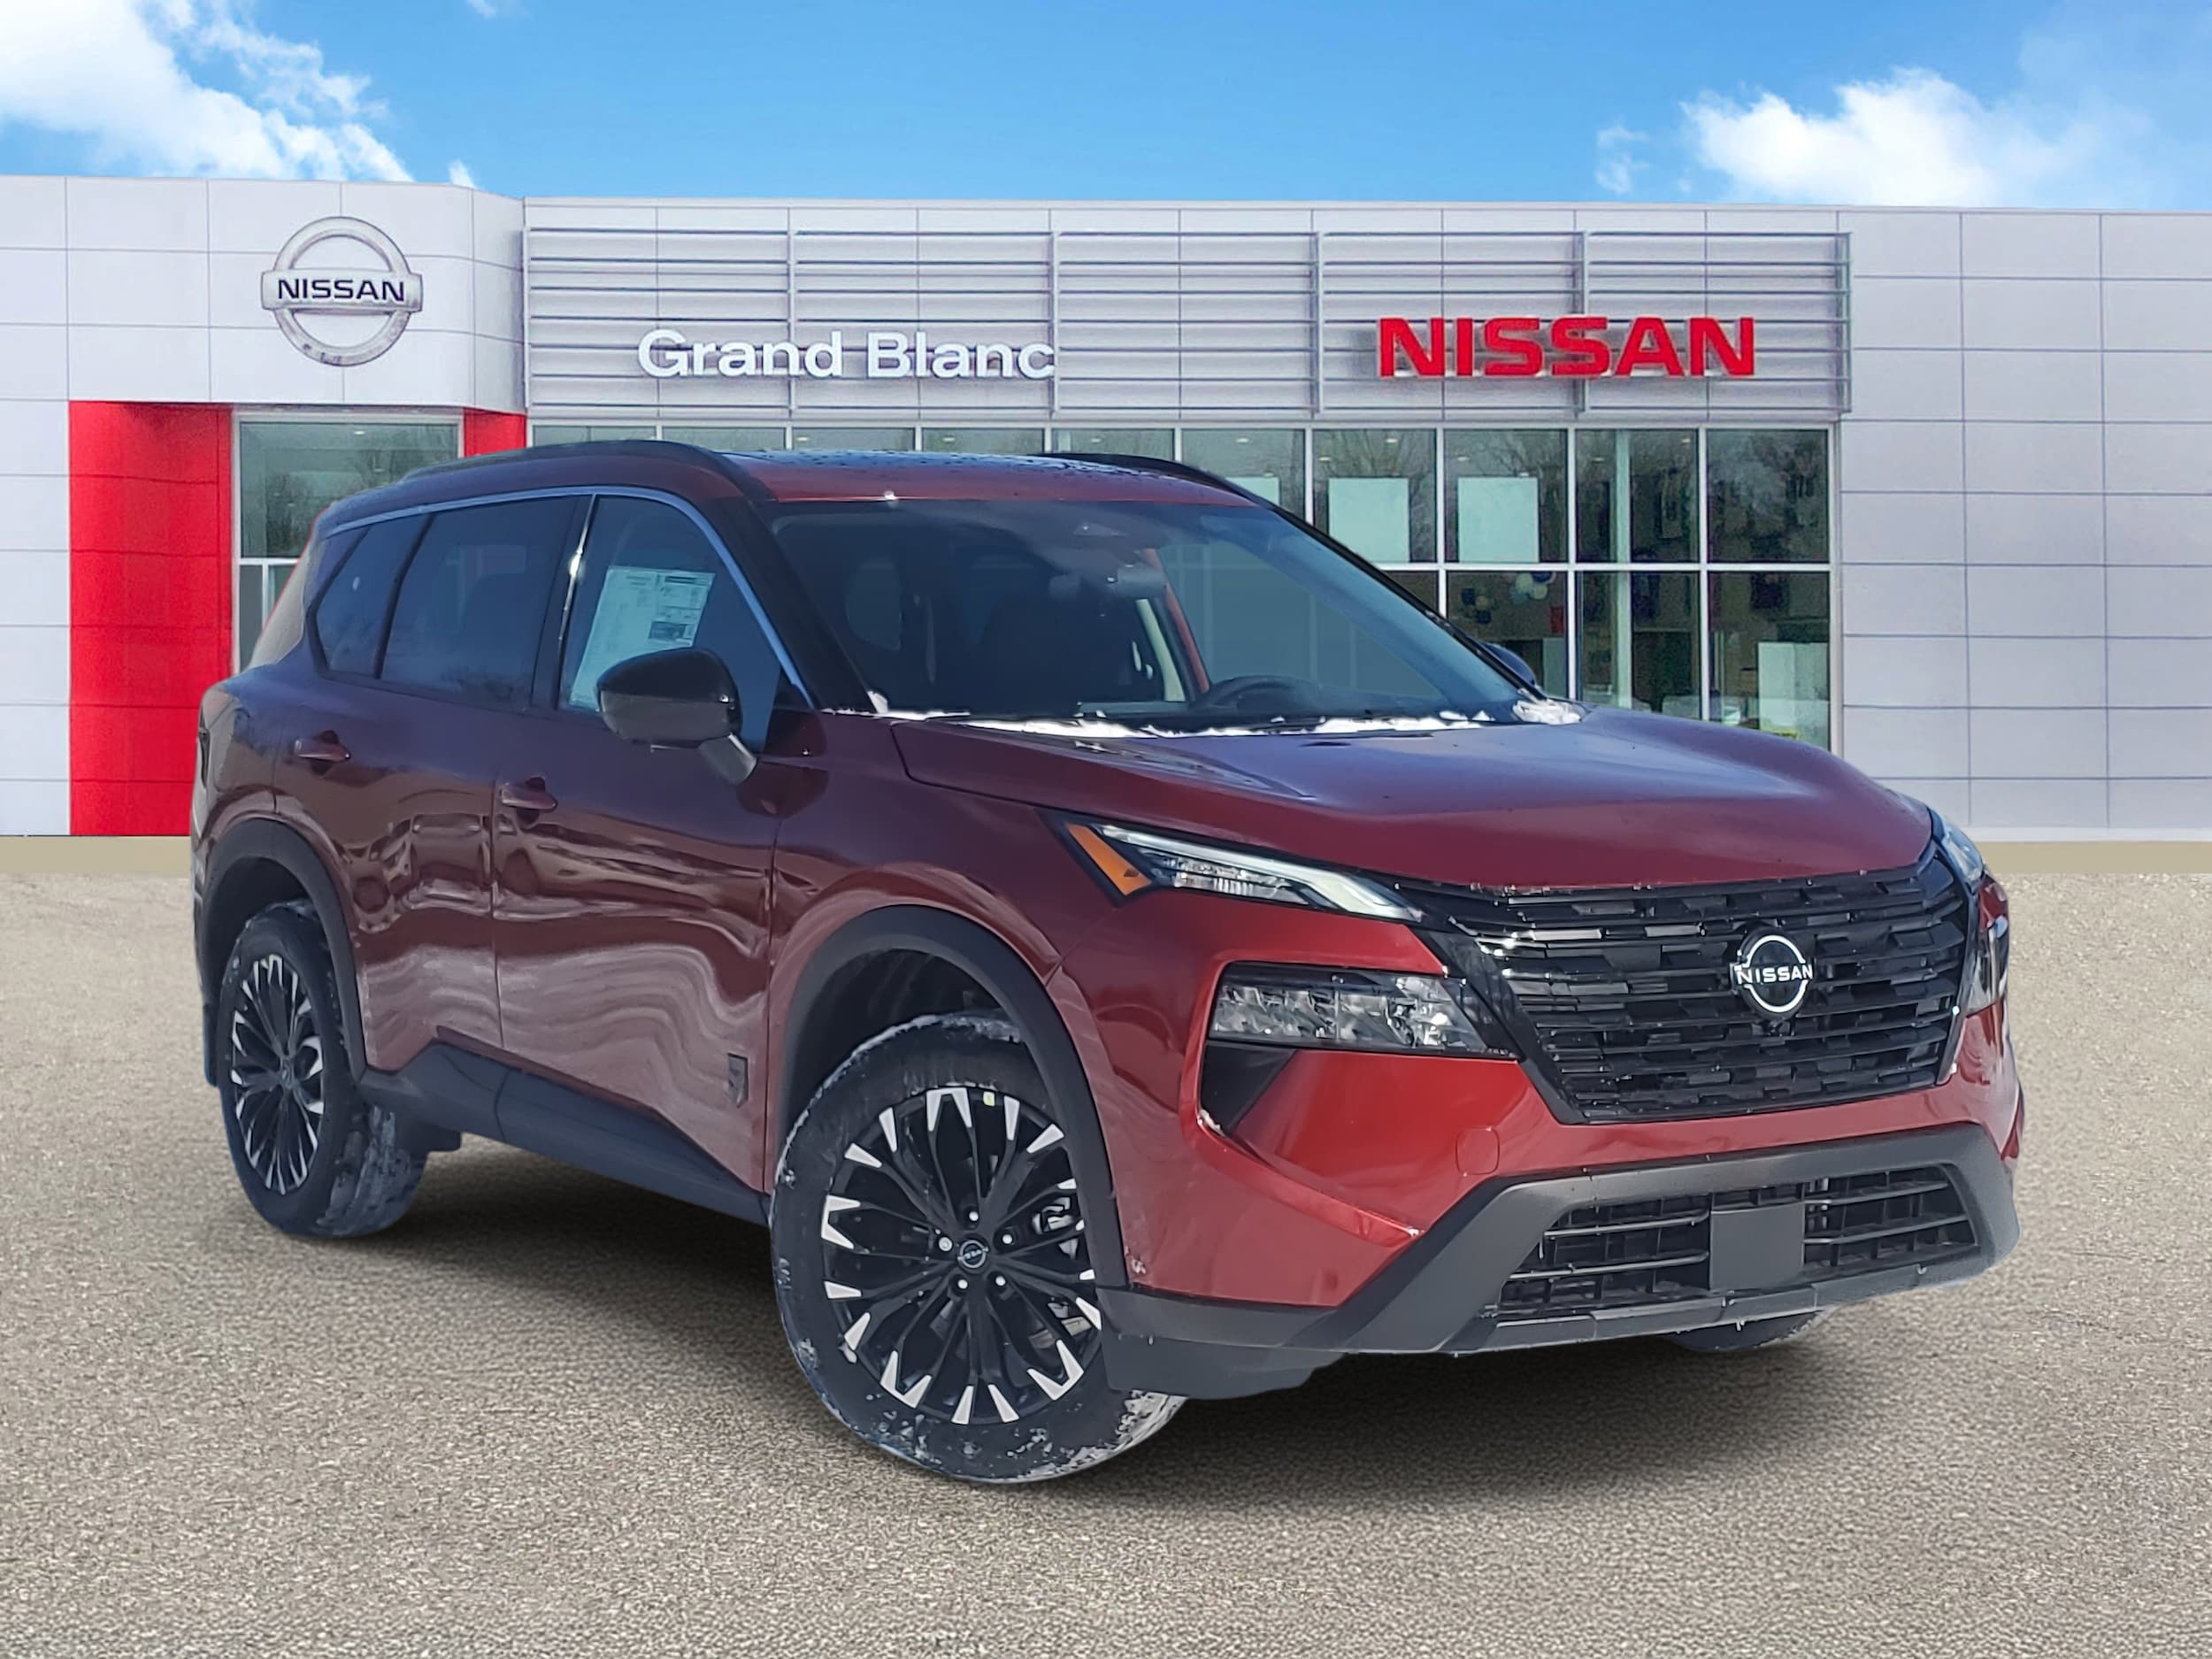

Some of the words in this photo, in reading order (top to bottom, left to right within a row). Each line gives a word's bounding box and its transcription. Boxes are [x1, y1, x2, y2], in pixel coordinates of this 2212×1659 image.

[278, 279, 404, 302] NISSAN
[637, 328, 842, 379] Grand
[866, 330, 1056, 379] Blanc
[1379, 317, 1755, 378] NISSAN
[1735, 964, 1813, 985] NISSAN
